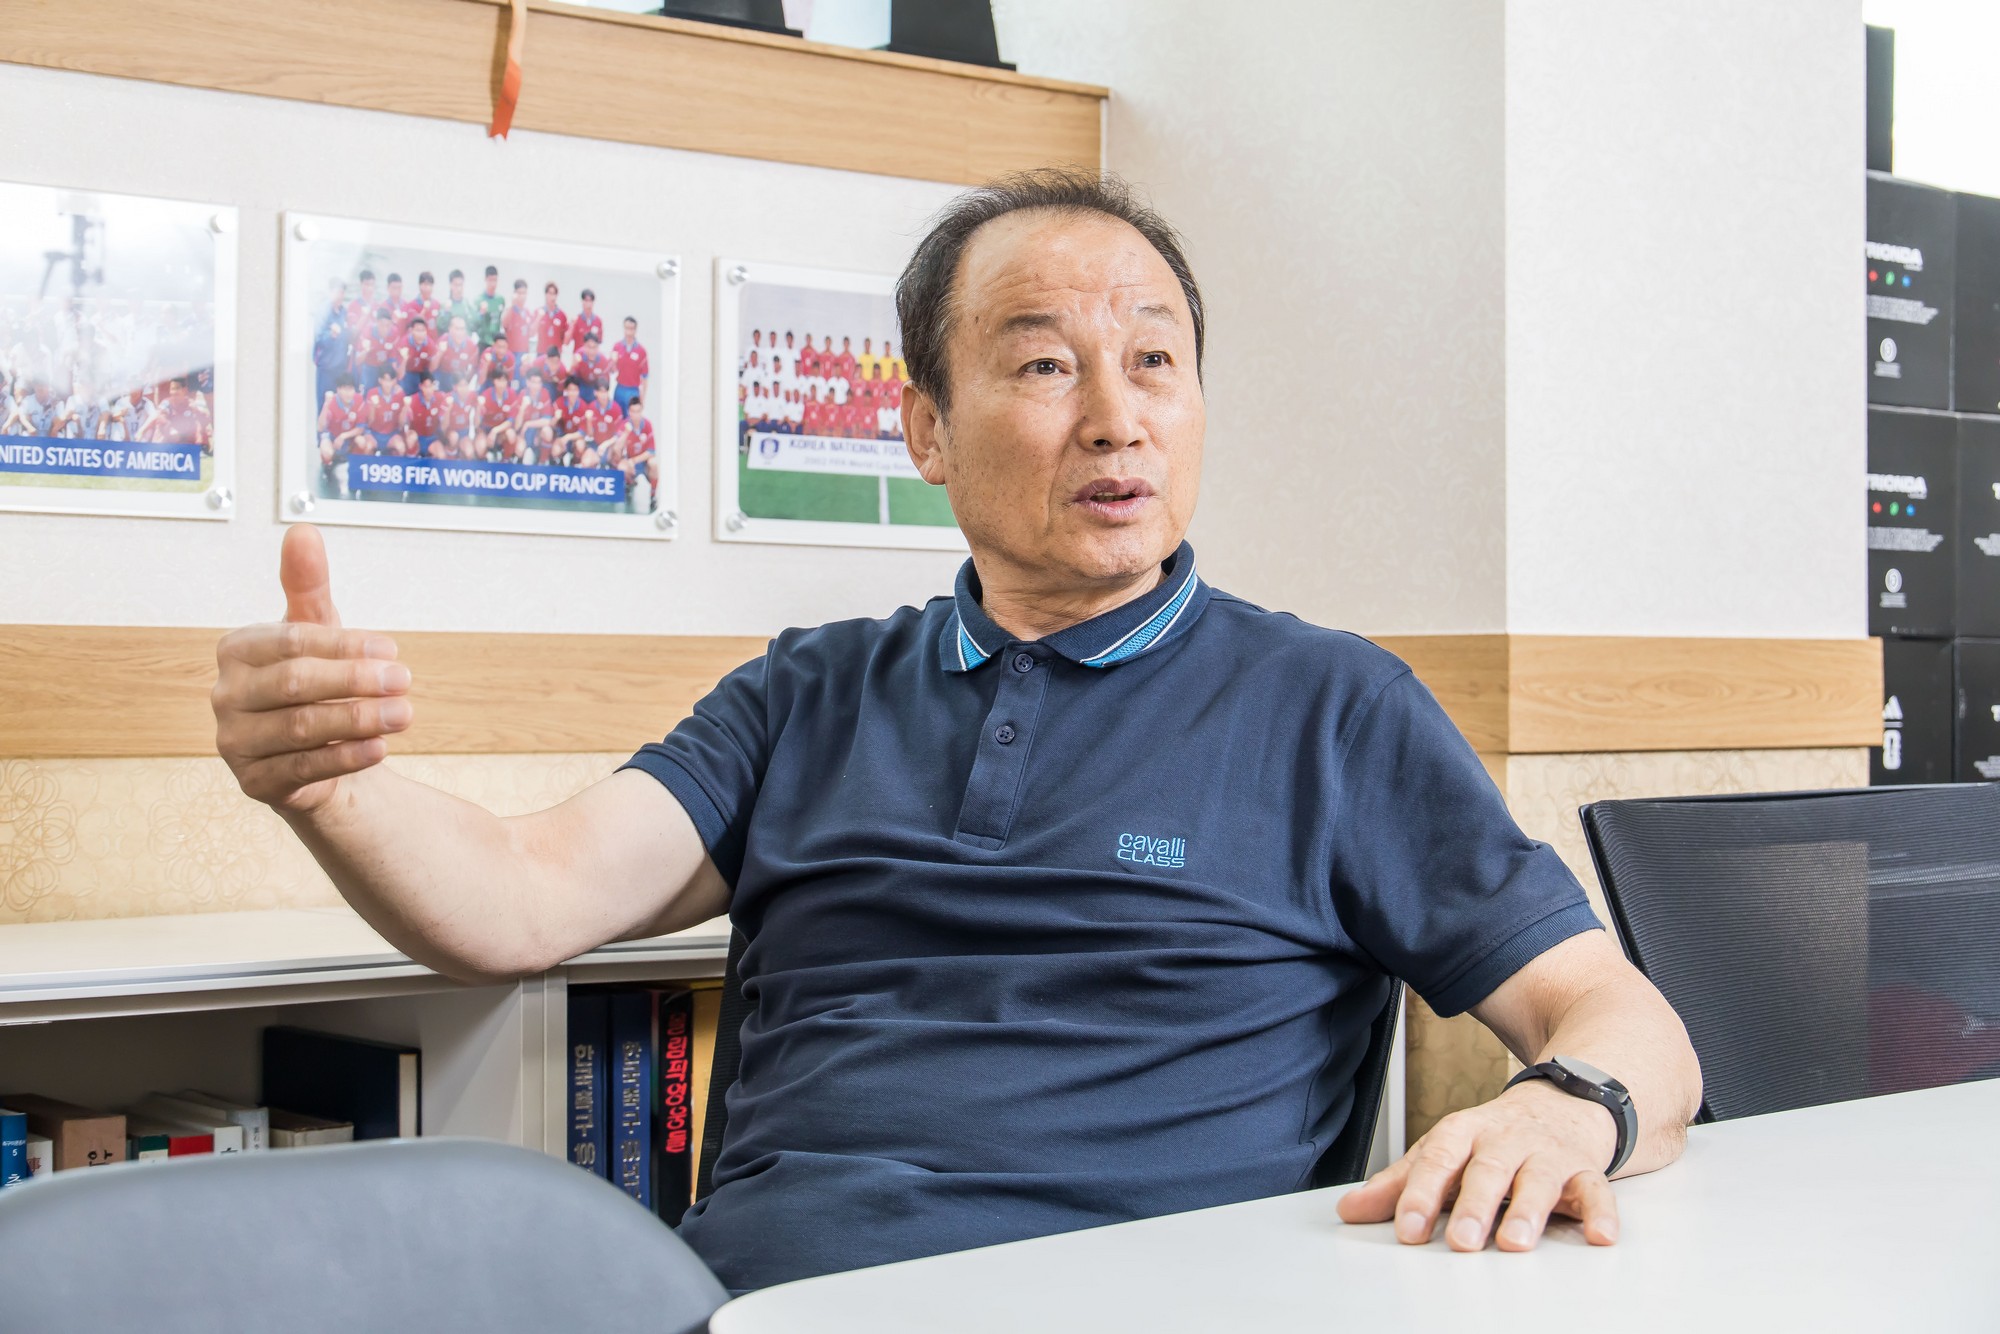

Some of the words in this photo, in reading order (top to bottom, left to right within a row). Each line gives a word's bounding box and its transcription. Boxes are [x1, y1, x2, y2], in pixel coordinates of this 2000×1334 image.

[1866, 241, 1923, 266] RIONDA
[0, 445, 43, 465] NITED
[45, 447, 101, 469] STATES
[103, 450, 125, 469] OF
[126, 451, 195, 473] AMERICA
[790, 439, 825, 451] KOREA
[830, 442, 879, 455] NATIONAL
[360, 463, 402, 485] 1998
[405, 465, 442, 487] FIFA
[443, 467, 509, 490] WORLD
[511, 472, 548, 493] CUP
[549, 474, 615, 496] FRANCE
[1118, 833, 1185, 857] cavalli
[1116, 848, 1185, 868] CLASS
